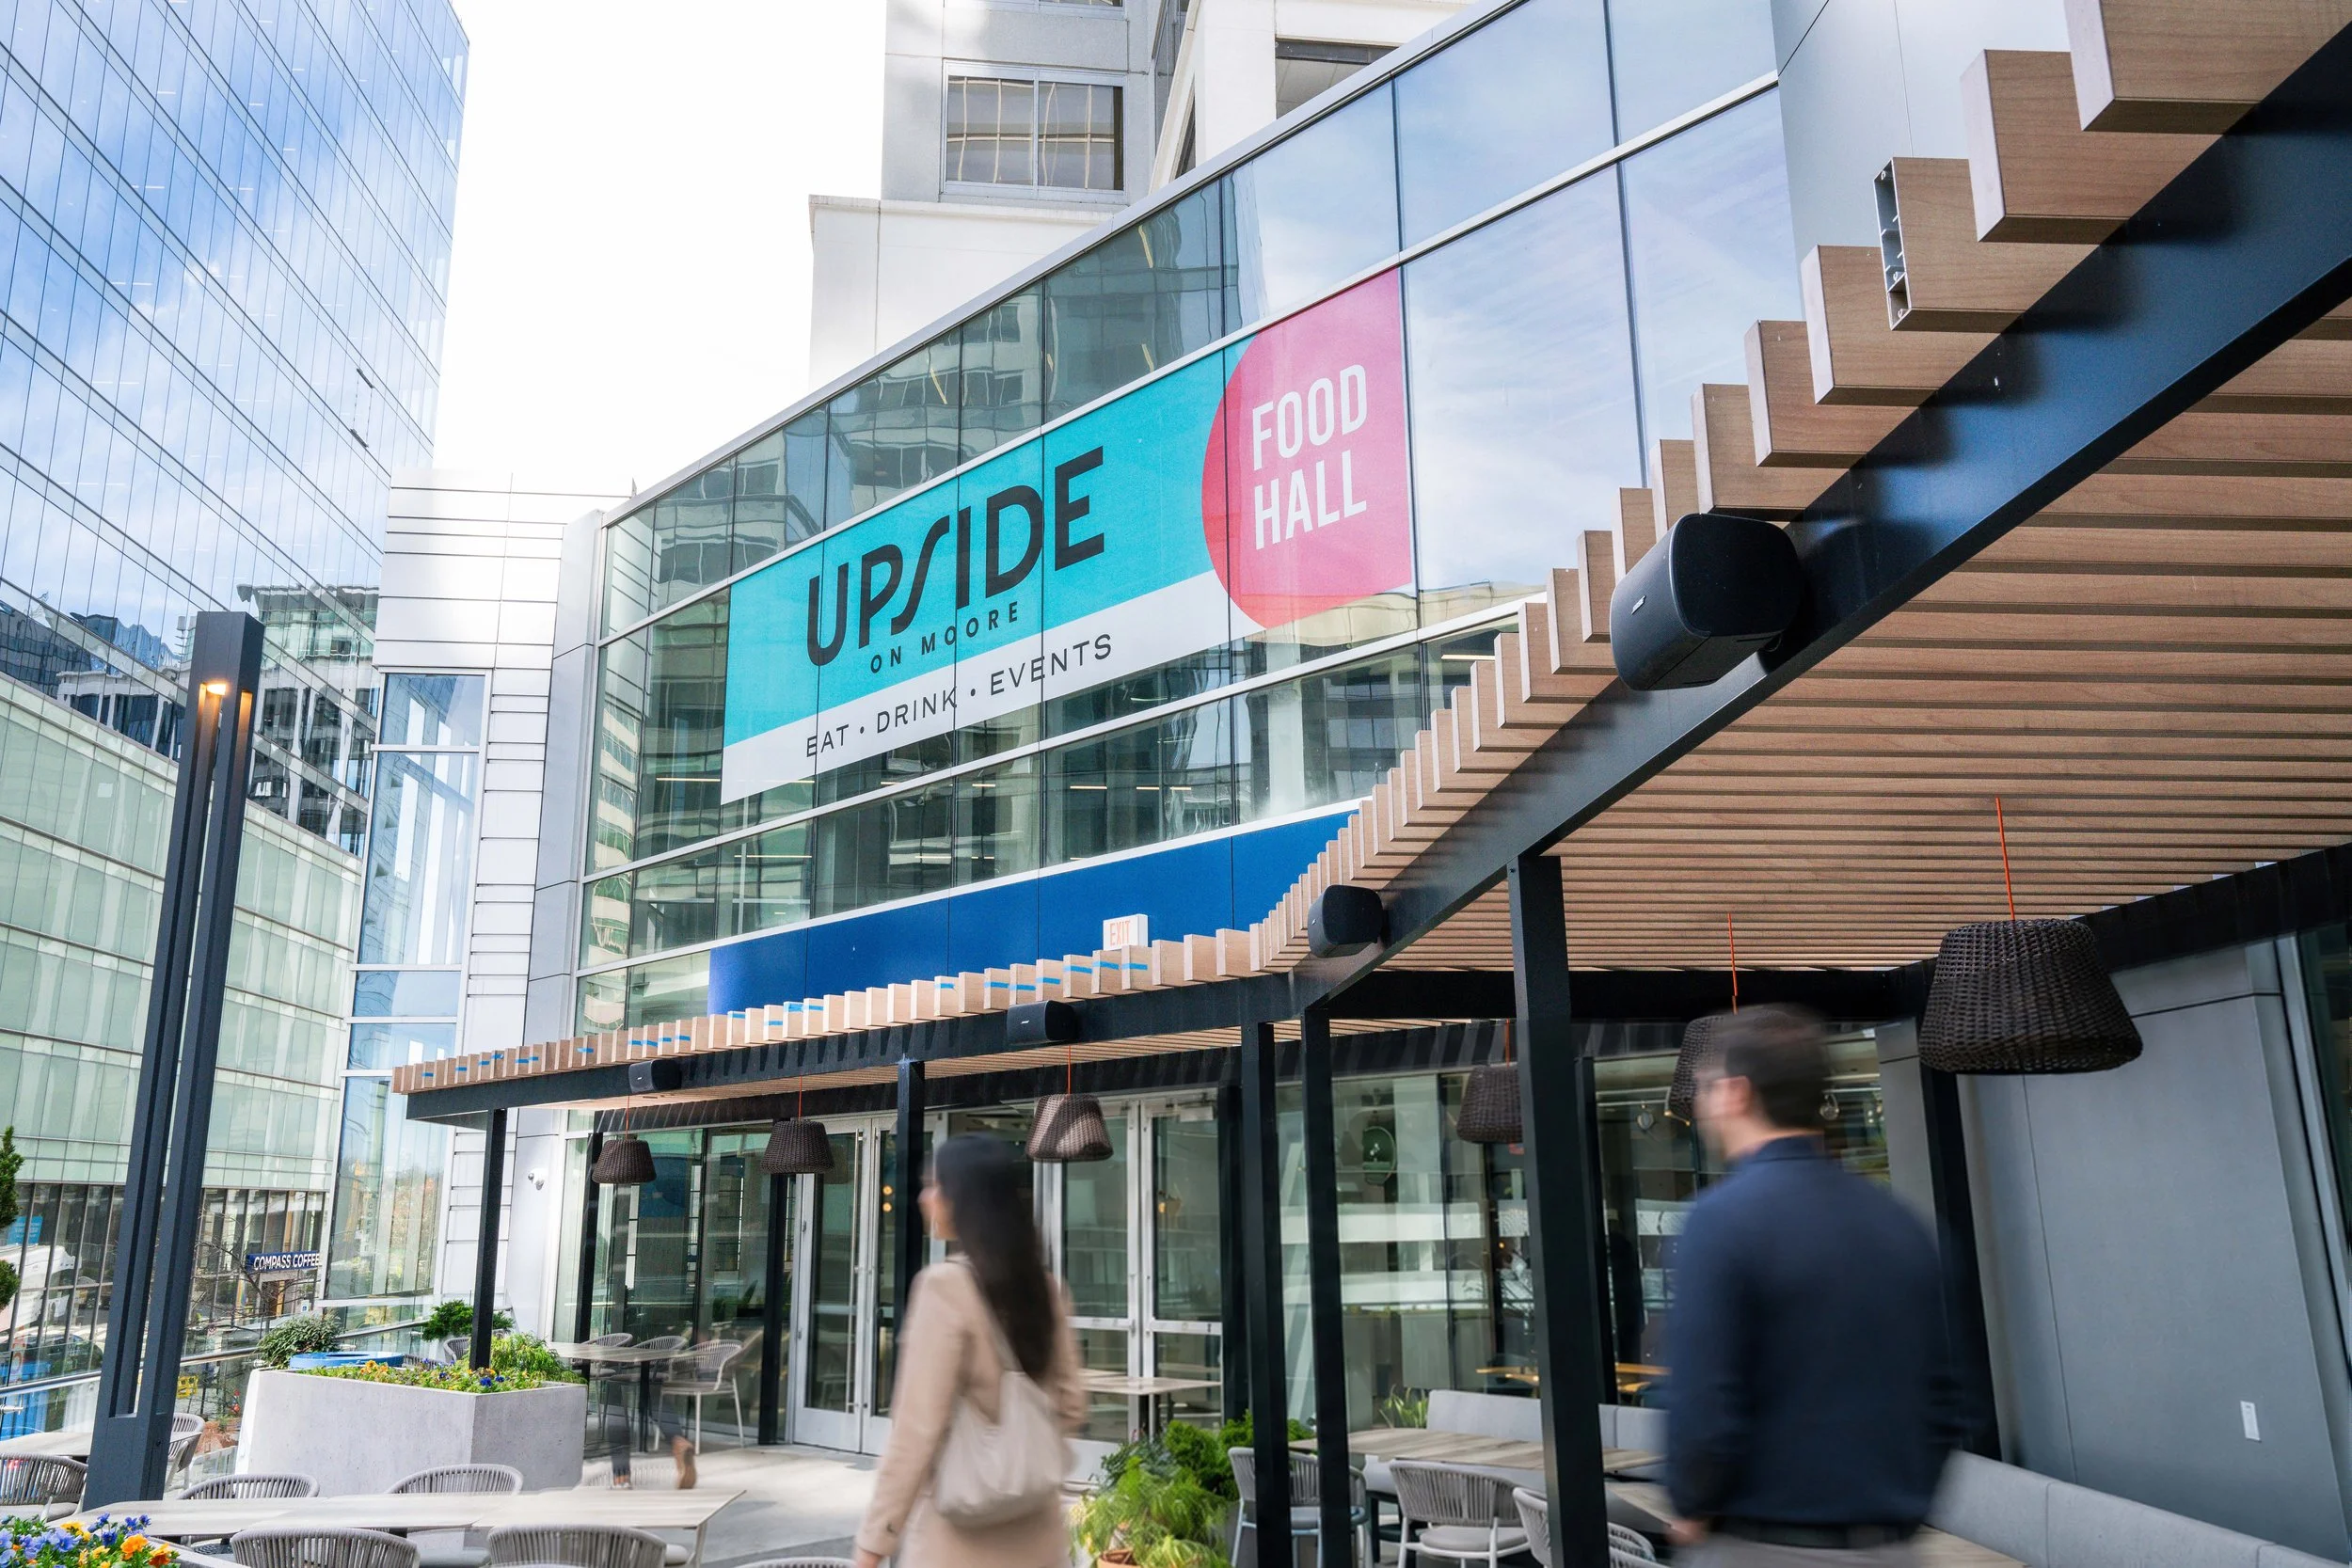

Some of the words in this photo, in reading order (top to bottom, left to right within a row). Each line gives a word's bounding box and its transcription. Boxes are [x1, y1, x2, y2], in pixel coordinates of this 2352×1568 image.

[1252, 364, 1368, 471] FOOD
[1254, 449, 1367, 550] HALL
[806, 445, 1104, 667] UPSIDE
[869, 645, 902, 674] ON
[921, 600, 1019, 656] MOORE
[806, 723, 850, 758] EAT
[877, 686, 958, 734] DRINK
[990, 633, 1112, 696] EVENTS
[1110, 920, 1130, 945] EXIT
[253, 1254, 292, 1271] COMPASS
[293, 1252, 320, 1268] COFFEE
